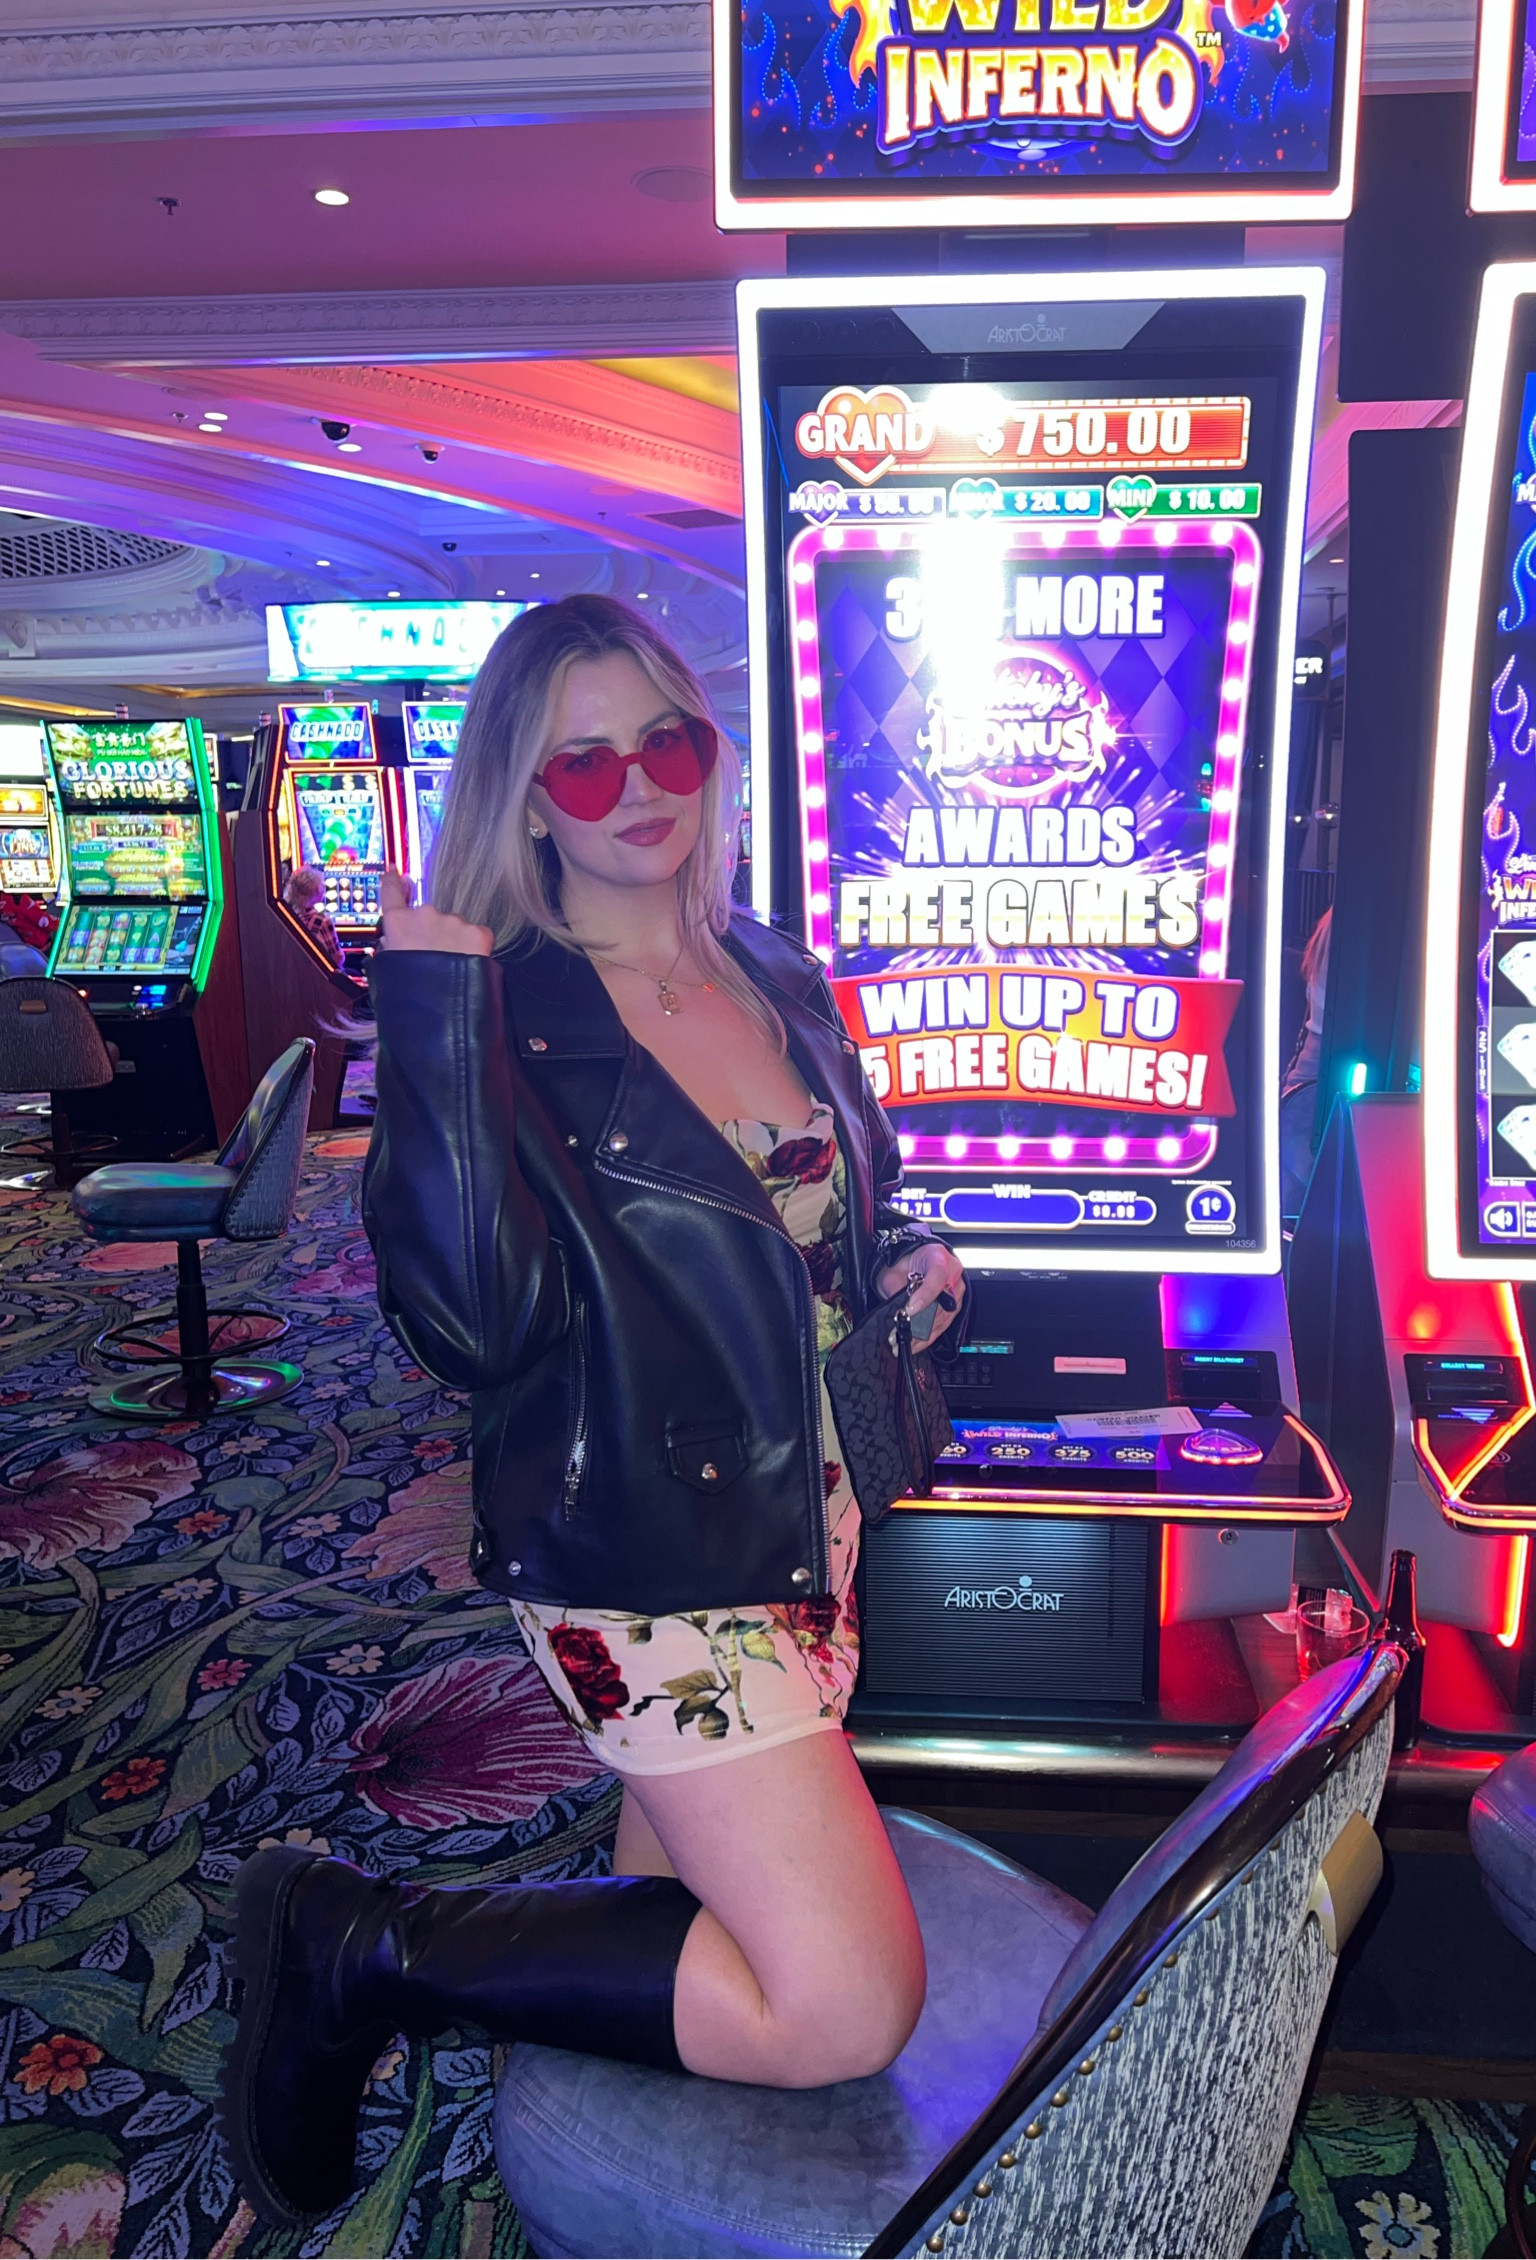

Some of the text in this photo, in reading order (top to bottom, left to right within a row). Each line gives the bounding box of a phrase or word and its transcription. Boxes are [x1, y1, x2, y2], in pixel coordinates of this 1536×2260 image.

[885, 37, 1195, 143] INFERNO
[986, 322, 1067, 343] ARISTOCRAT
[798, 411, 933, 455] GRAND
[789, 492, 849, 512] MAJOR
[1108, 489, 1153, 508] MINI
[1015, 574, 1165, 637] MORE
[941, 710, 1093, 767] BONUS
[62, 761, 191, 780] GLORIOUS
[74, 780, 189, 799] FORTUNES
[903, 806, 1136, 866] AWARDS
[839, 879, 1200, 947] FREE GAMES
[859, 974, 1179, 1040] WIN UP TO
[899, 1033, 1007, 1096] FREE
[1018, 1034, 1208, 1108] GAMES!
[992, 1184, 1031, 1198] WIN
[1088, 1190, 1137, 1203] CREDIT
[1225, 1239, 1257, 1249] 104356
[991, 1447, 1031, 1456] 250
[1055, 1449, 1091, 1458] 375
[1115, 1451, 1155, 1460] 500
[944, 1585, 1064, 1611] ARISTOCRAT
